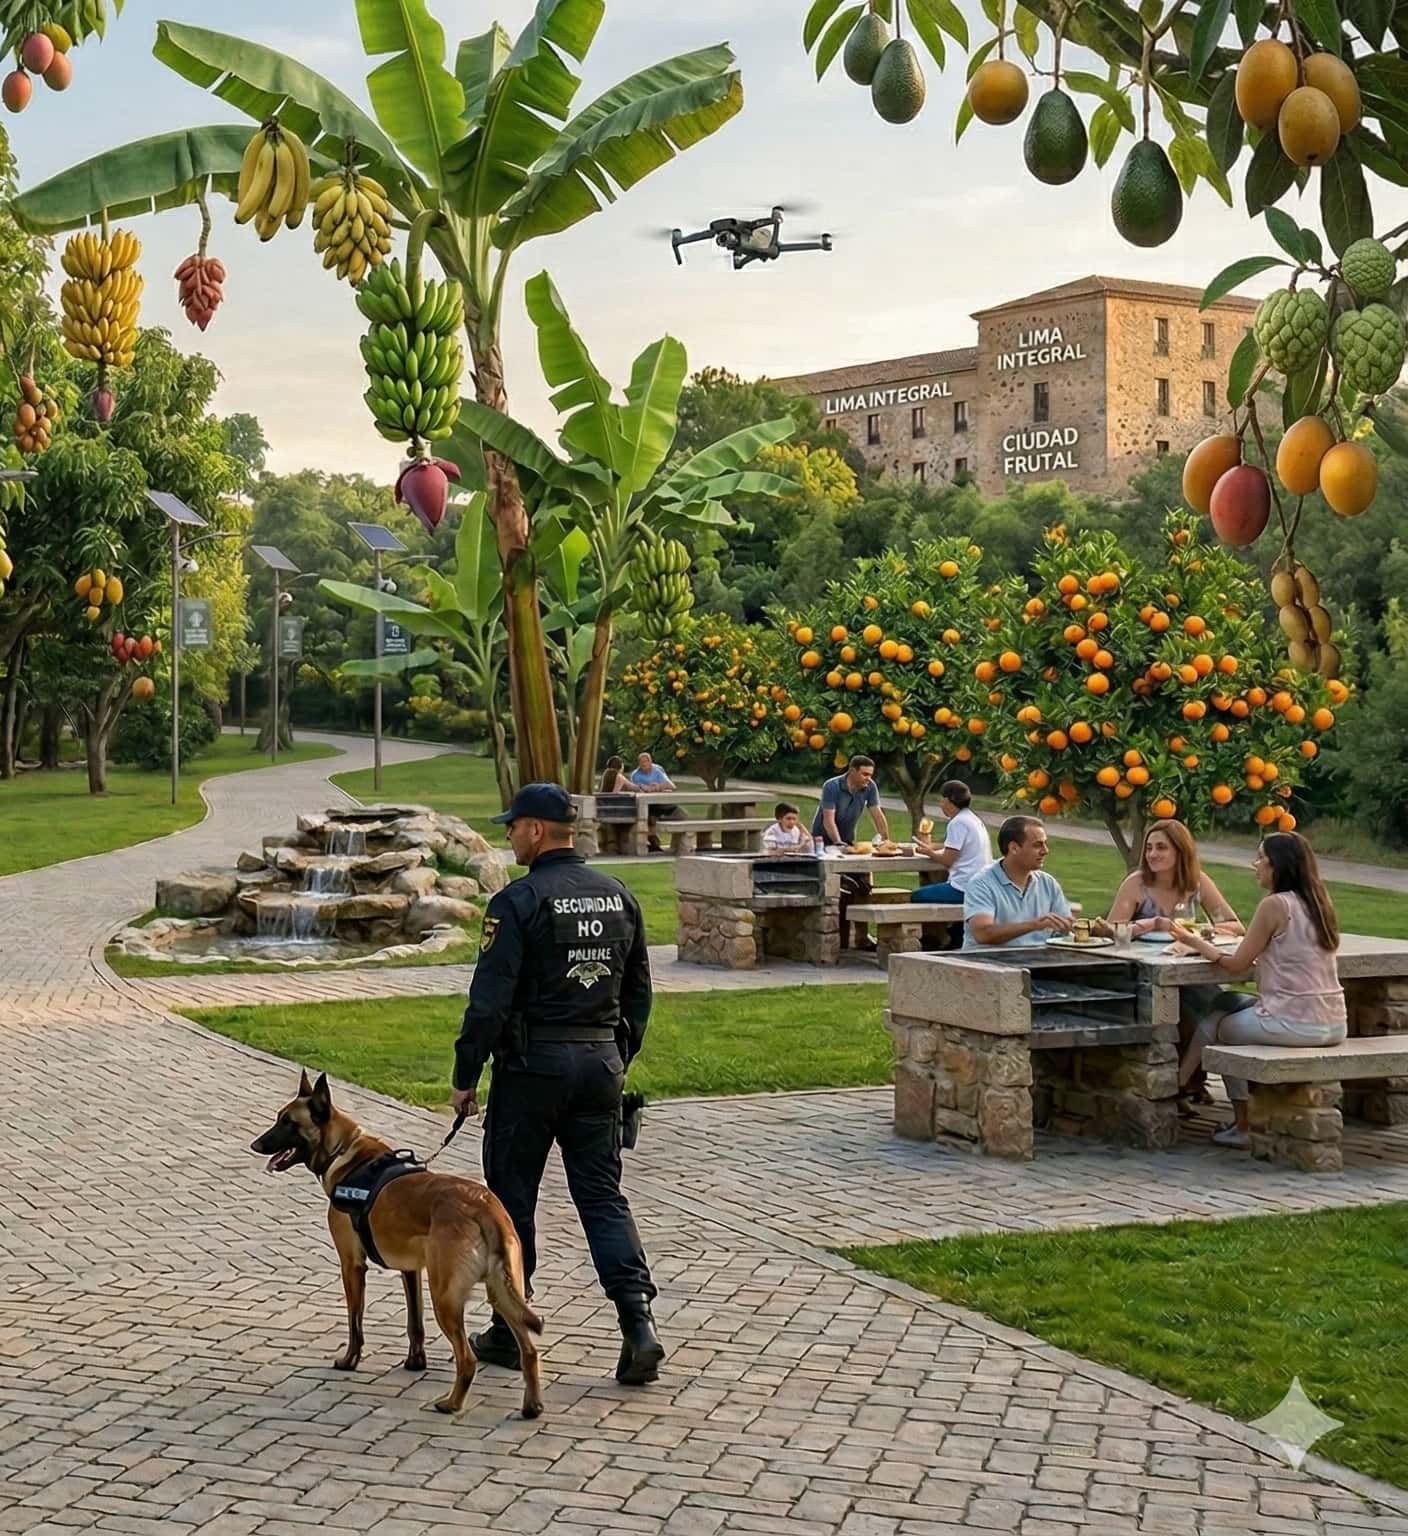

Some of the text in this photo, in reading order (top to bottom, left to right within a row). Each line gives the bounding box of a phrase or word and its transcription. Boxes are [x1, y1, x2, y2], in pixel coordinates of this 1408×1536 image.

[1018, 327, 1063, 348] LIMA
[997, 343, 1087, 370] INTEGRAL
[826, 382, 953, 414] LIMA INTEGRAL
[1002, 427, 1078, 453] CIUDAD
[1003, 450, 1078, 474] FRUTAL
